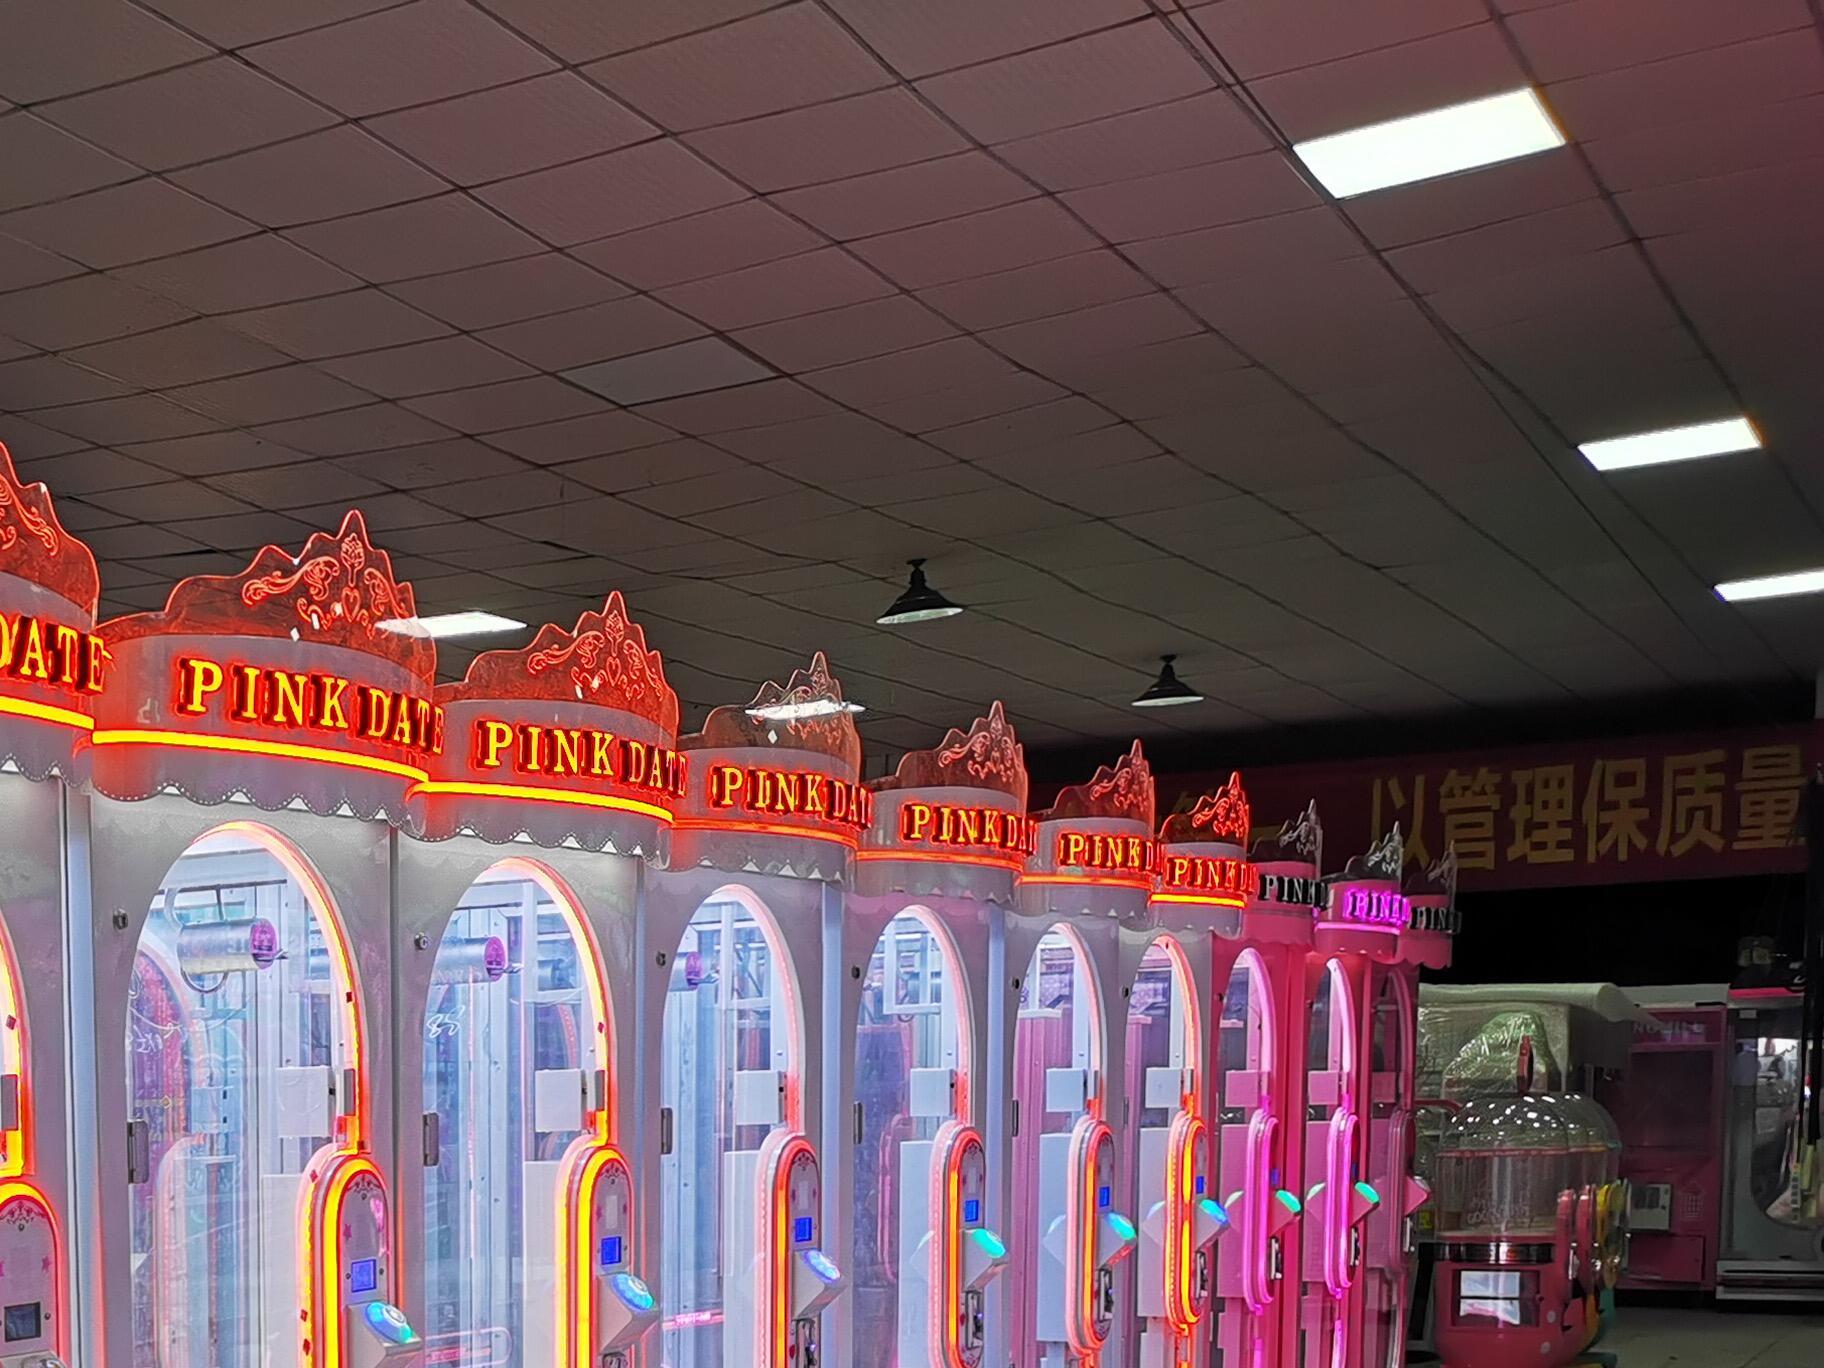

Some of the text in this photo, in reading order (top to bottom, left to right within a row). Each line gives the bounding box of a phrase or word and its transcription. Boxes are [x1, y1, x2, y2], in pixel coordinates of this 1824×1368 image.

[176, 657, 444, 755] PINK DATE
[476, 719, 614, 777] PINK
[711, 765, 824, 815] PINK
[903, 803, 1000, 845] PINK
[1060, 833, 1141, 870] PINK
[1166, 856, 1236, 890] PINK
